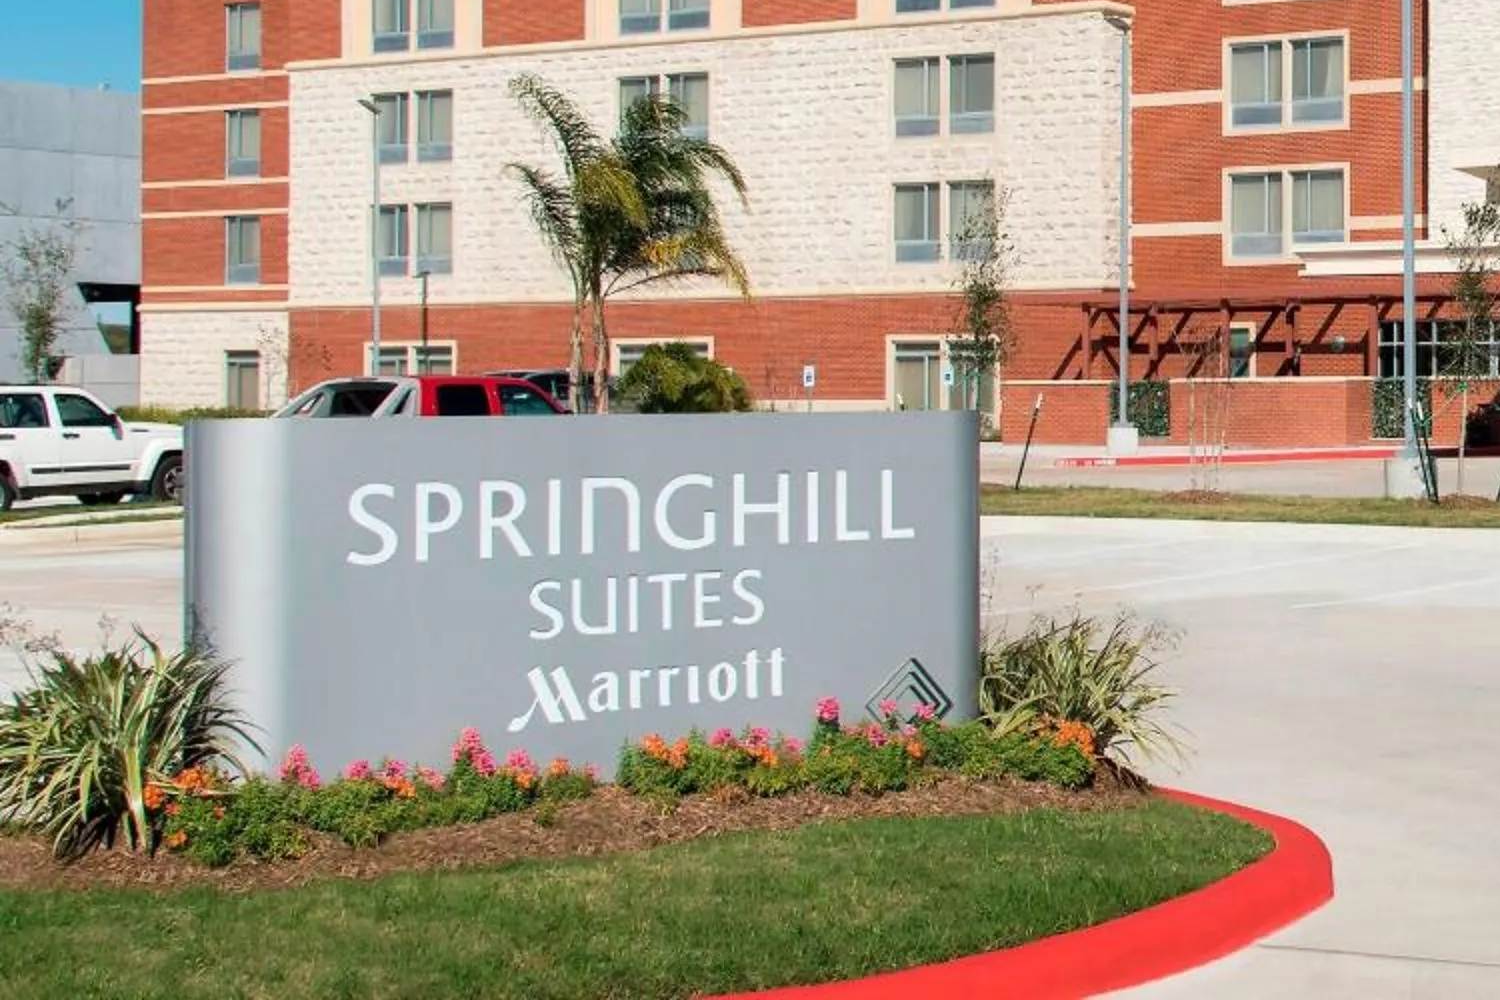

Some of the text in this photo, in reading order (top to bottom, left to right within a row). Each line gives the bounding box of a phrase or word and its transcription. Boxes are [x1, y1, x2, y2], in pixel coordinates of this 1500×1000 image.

[346, 468, 916, 567] SPRINGHILL
[528, 568, 765, 640] SUITES
[507, 647, 786, 733] Marriott
